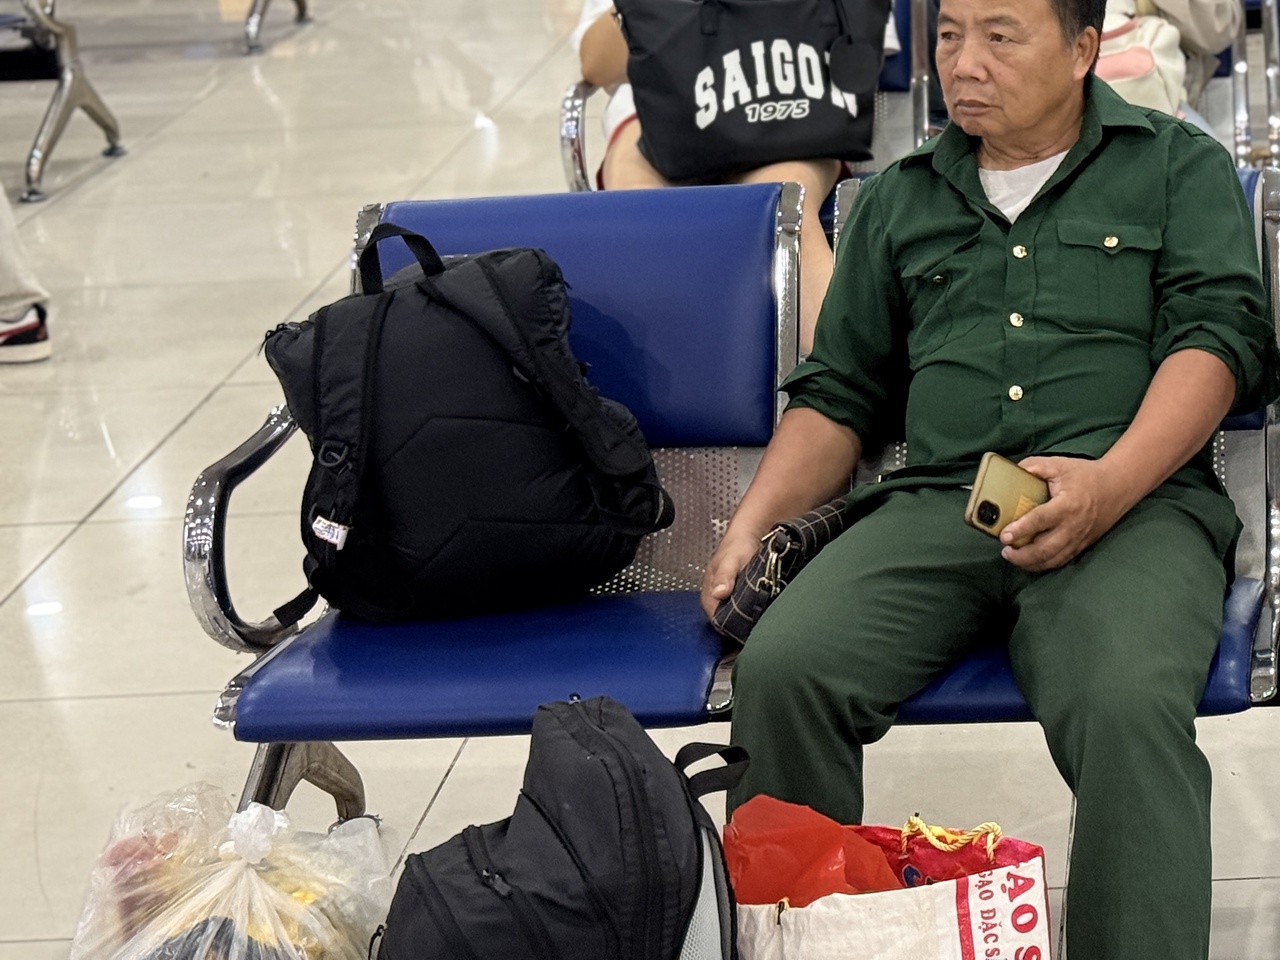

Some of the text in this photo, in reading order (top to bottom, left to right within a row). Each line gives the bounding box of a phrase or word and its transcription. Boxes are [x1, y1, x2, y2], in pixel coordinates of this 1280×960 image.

[745, 99, 810, 123] 1975
[1001, 869, 1039, 934] ẠO
[978, 907, 1003, 944] ĐẶC
